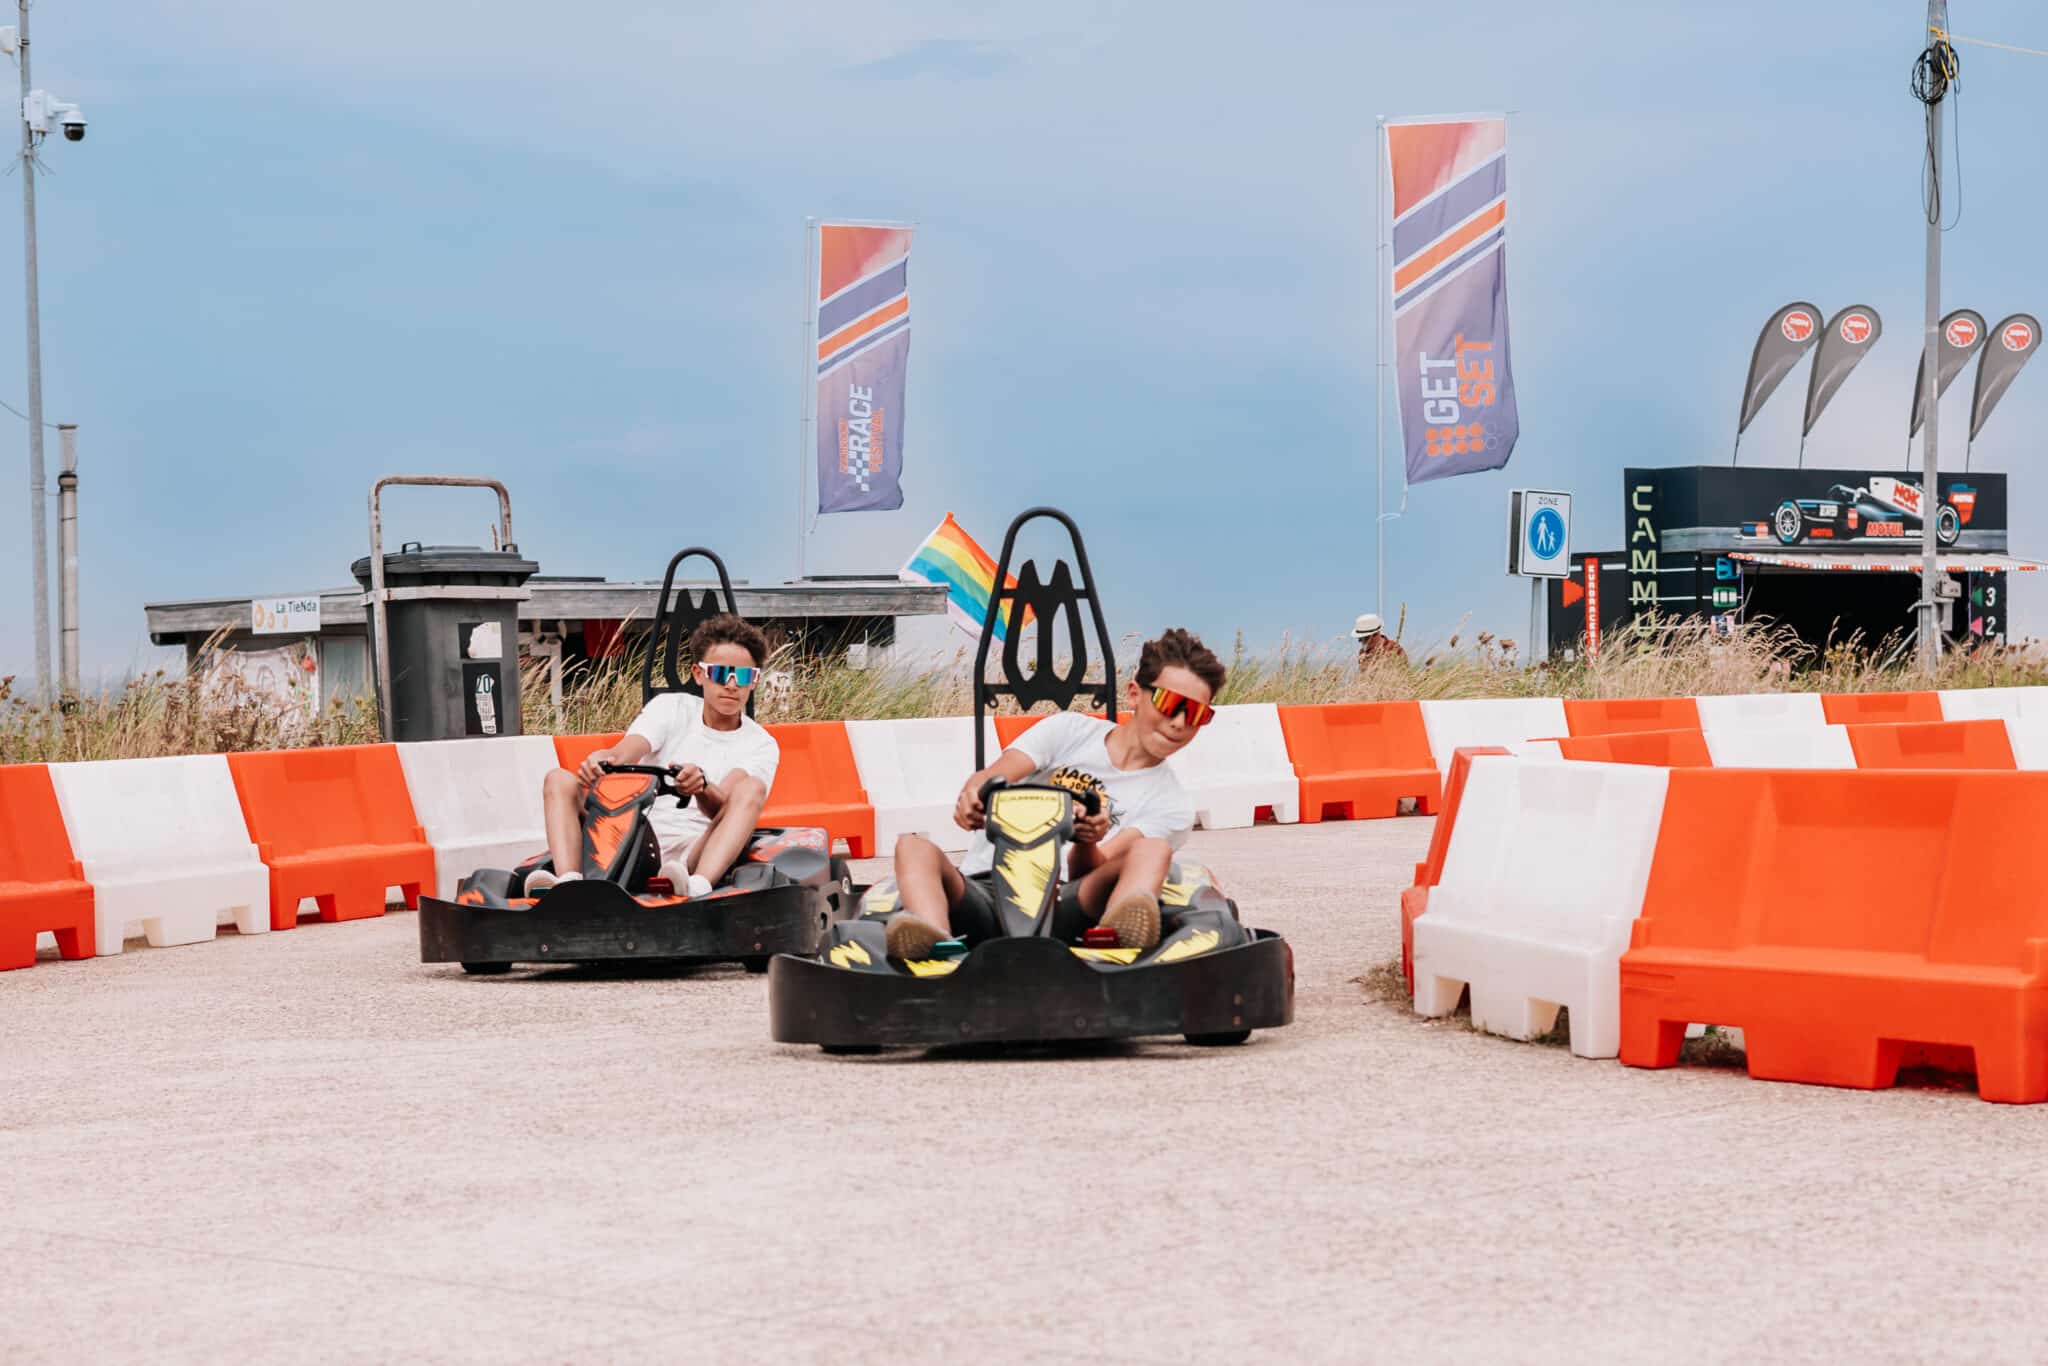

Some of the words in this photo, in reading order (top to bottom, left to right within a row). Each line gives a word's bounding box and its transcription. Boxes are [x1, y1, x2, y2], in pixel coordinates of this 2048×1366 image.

[1455, 333, 1496, 407] SET
[1420, 351, 1460, 425] GET
[848, 384, 872, 454] RACE
[1537, 496, 1561, 506] ZONE
[1865, 521, 1904, 537] MOTUL
[1985, 587, 1997, 607] 3
[1985, 616, 1997, 636] 2
